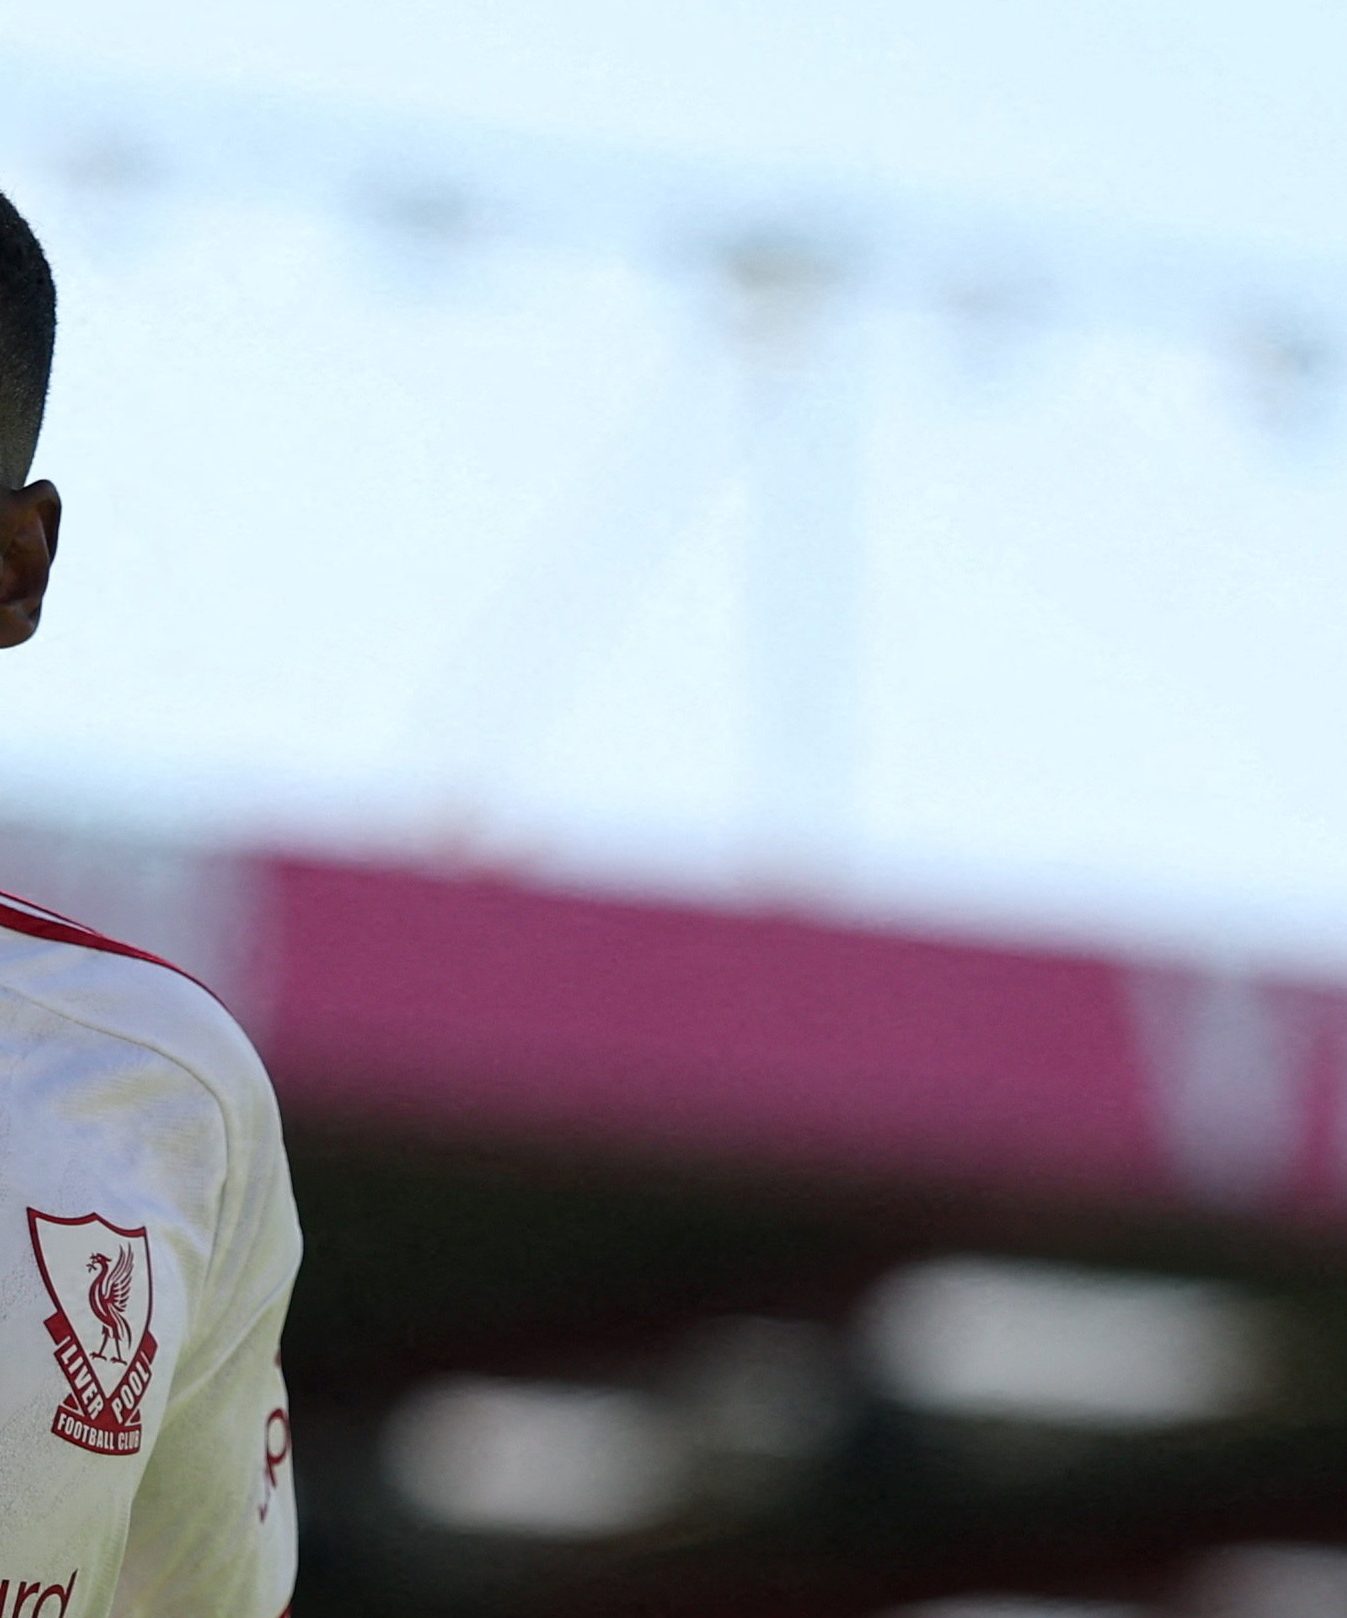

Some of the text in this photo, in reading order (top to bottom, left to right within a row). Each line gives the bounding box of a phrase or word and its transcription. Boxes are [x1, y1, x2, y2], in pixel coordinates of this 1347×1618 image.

[61, 1344, 150, 1424] LIVER POOL
[57, 1412, 141, 1451] FOOTBALL CLUB
